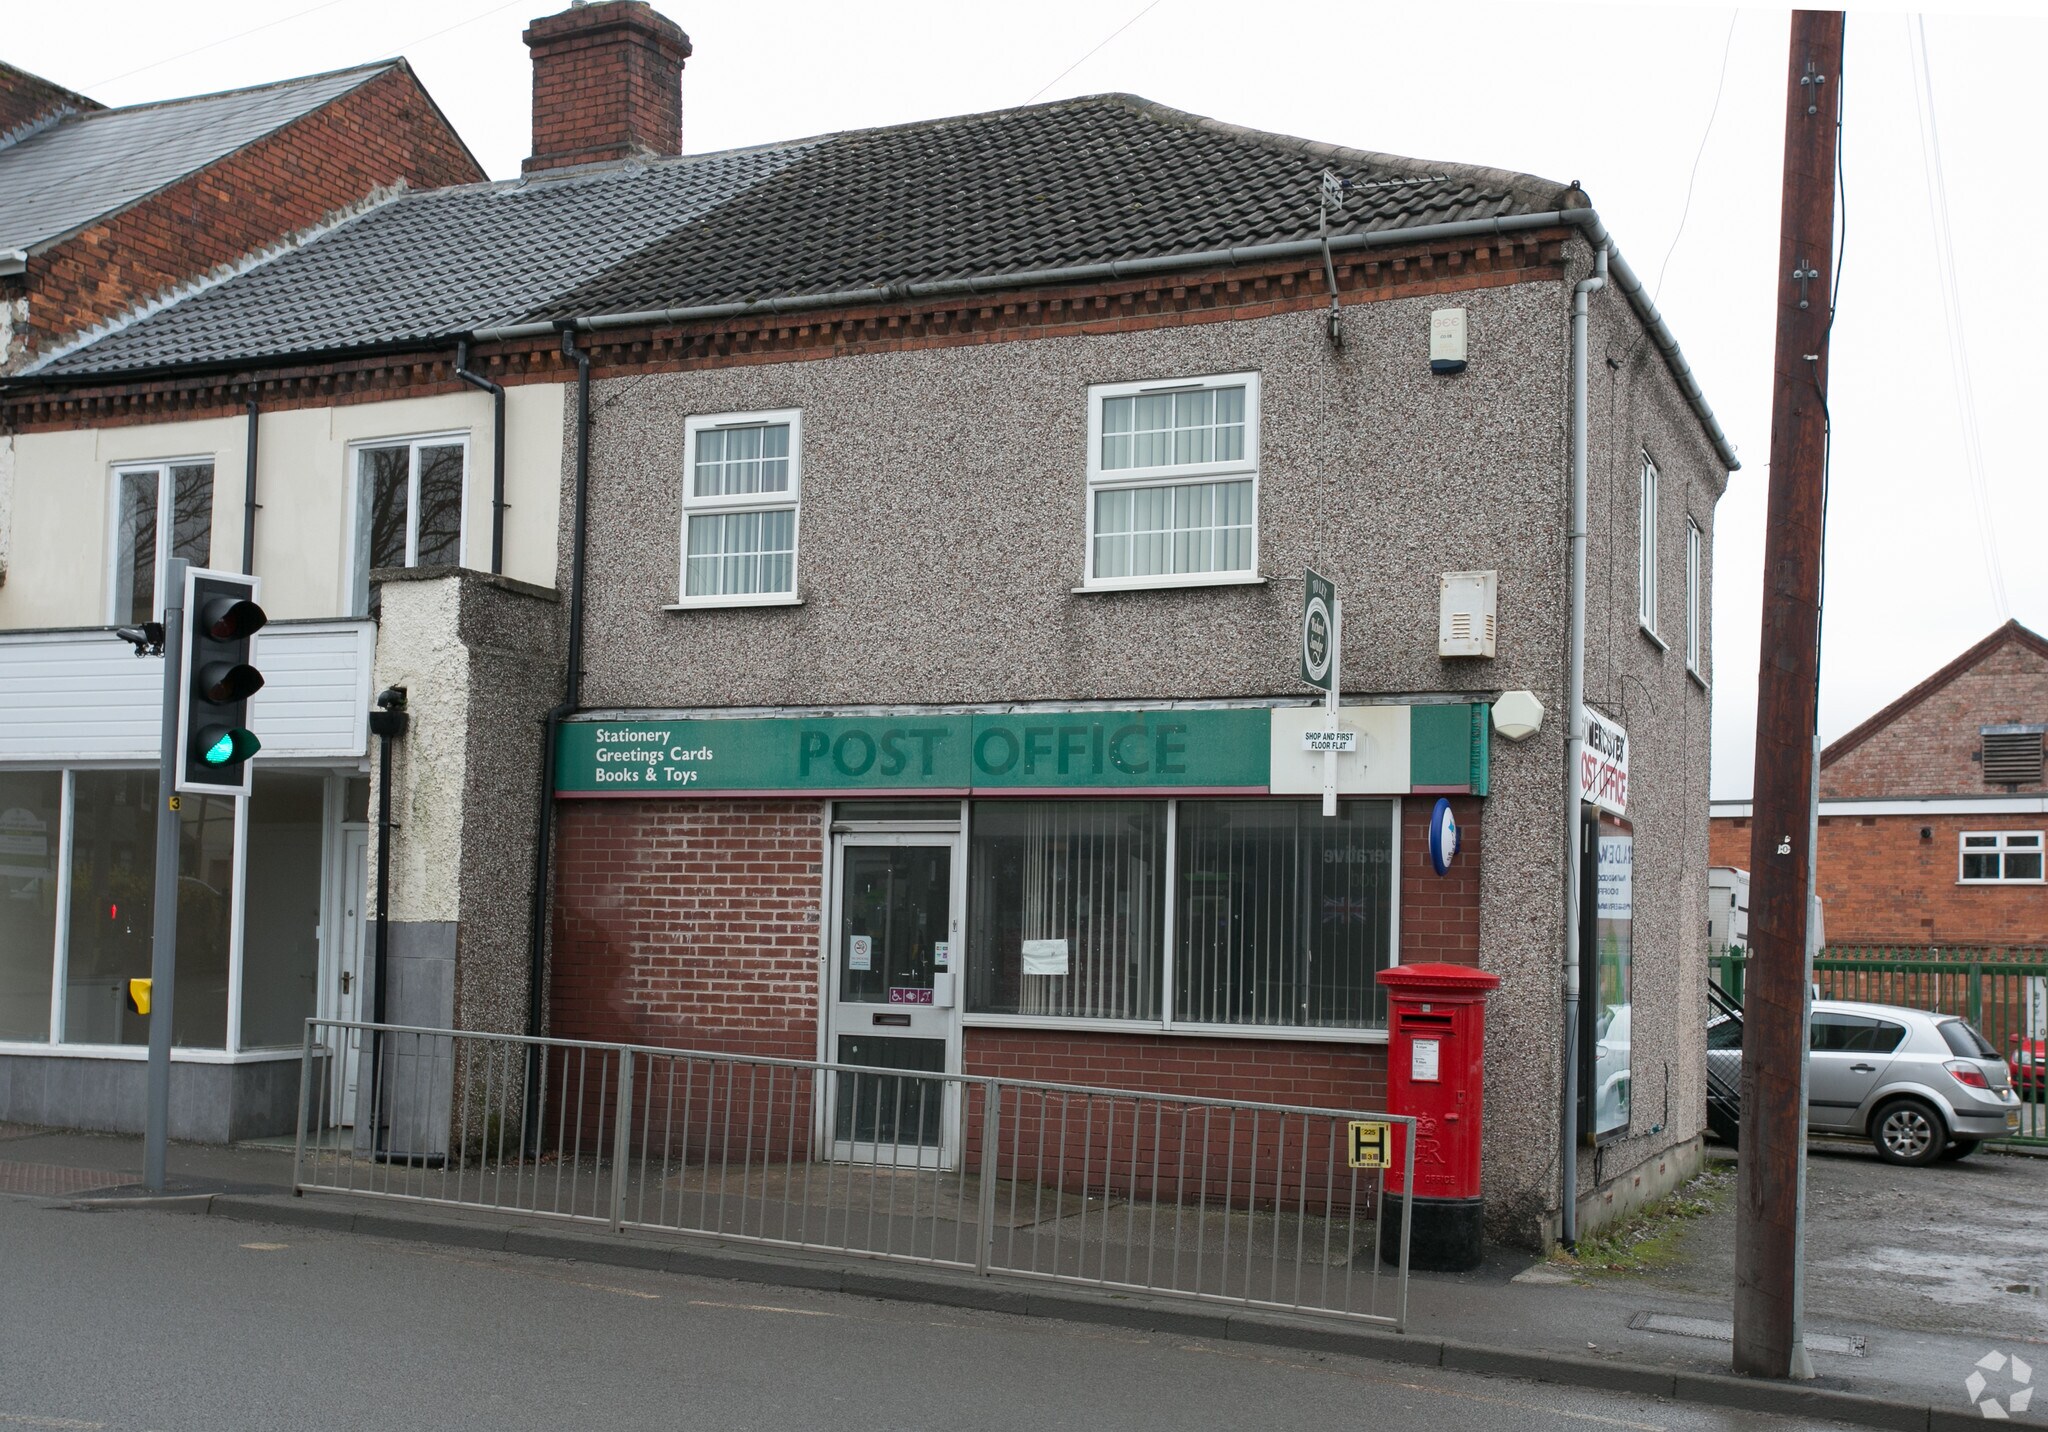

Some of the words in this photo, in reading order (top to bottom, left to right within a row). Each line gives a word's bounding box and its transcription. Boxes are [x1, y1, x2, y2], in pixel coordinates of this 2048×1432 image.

[1318, 580, 1328, 600] LET
[596, 728, 671, 746] Stationery
[1305, 732, 1322, 741] SHOP
[1322, 732, 1336, 741] AND
[1336, 732, 1354, 742] FIRST
[1311, 741, 1331, 750] FLOOR
[1332, 741, 1347, 750] FLAT
[595, 747, 664, 766] Greetings
[670, 746, 713, 761] Cards
[800, 728, 949, 777] POST
[973, 724, 1188, 776] OFFICE
[595, 767, 639, 782] Books
[645, 767, 657, 782] &
[663, 767, 697, 786] Toys
[1580, 751, 1598, 794] OST
[1600, 760, 1627, 807] OFFICE
[171, 796, 180, 810] 3
[1363, 1128, 1376, 1136] 225
[1355, 1126, 1385, 1163] H
[1367, 1153, 1373, 1161] 3
[1425, 1174, 1456, 1185] OFFICE
